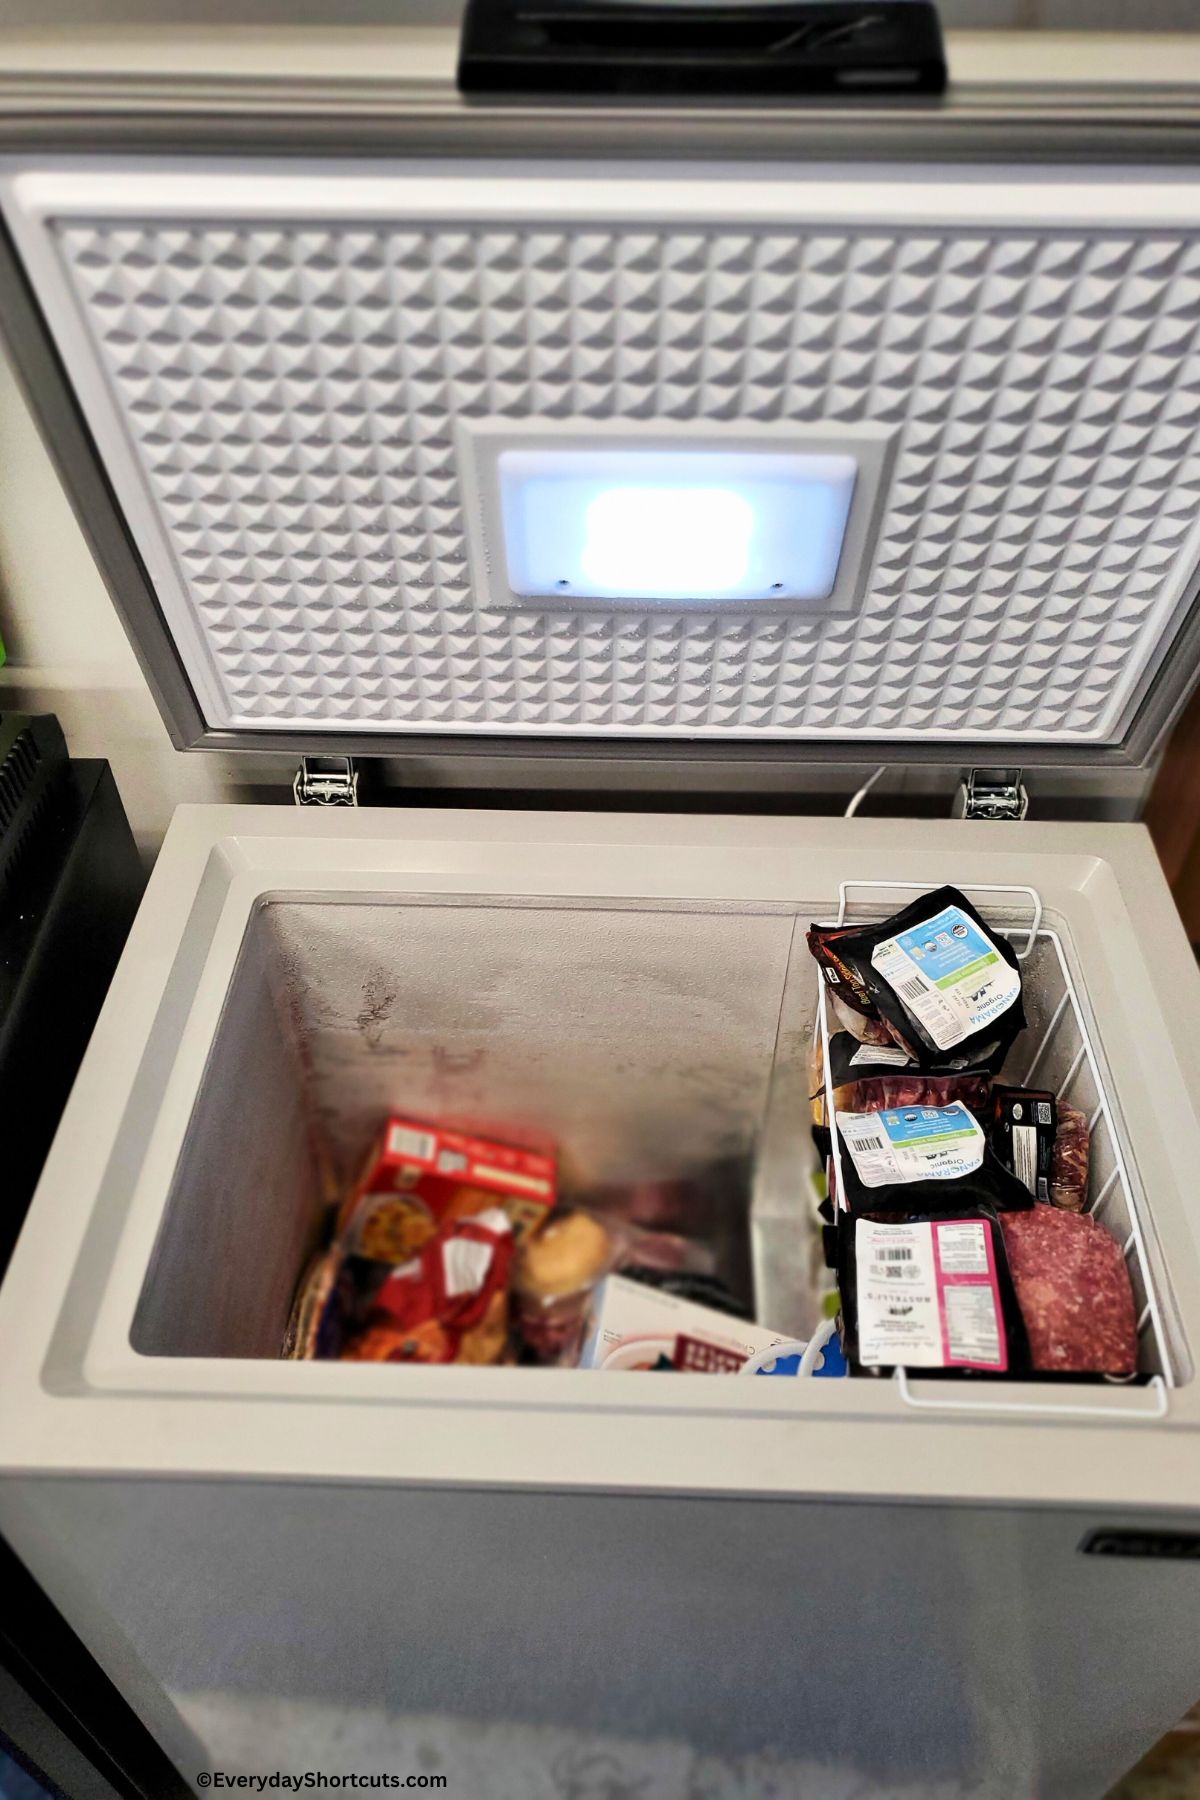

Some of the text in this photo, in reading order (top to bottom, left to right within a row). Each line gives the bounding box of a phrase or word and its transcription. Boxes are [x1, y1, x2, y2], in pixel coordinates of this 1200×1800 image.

[854, 990, 870, 1004] Beef
[977, 994, 1003, 1011] Organic
[969, 987, 1018, 1025] PANORAMA
[917, 1158, 980, 1177] PANORAMA
[930, 1159, 964, 1169] Organic
